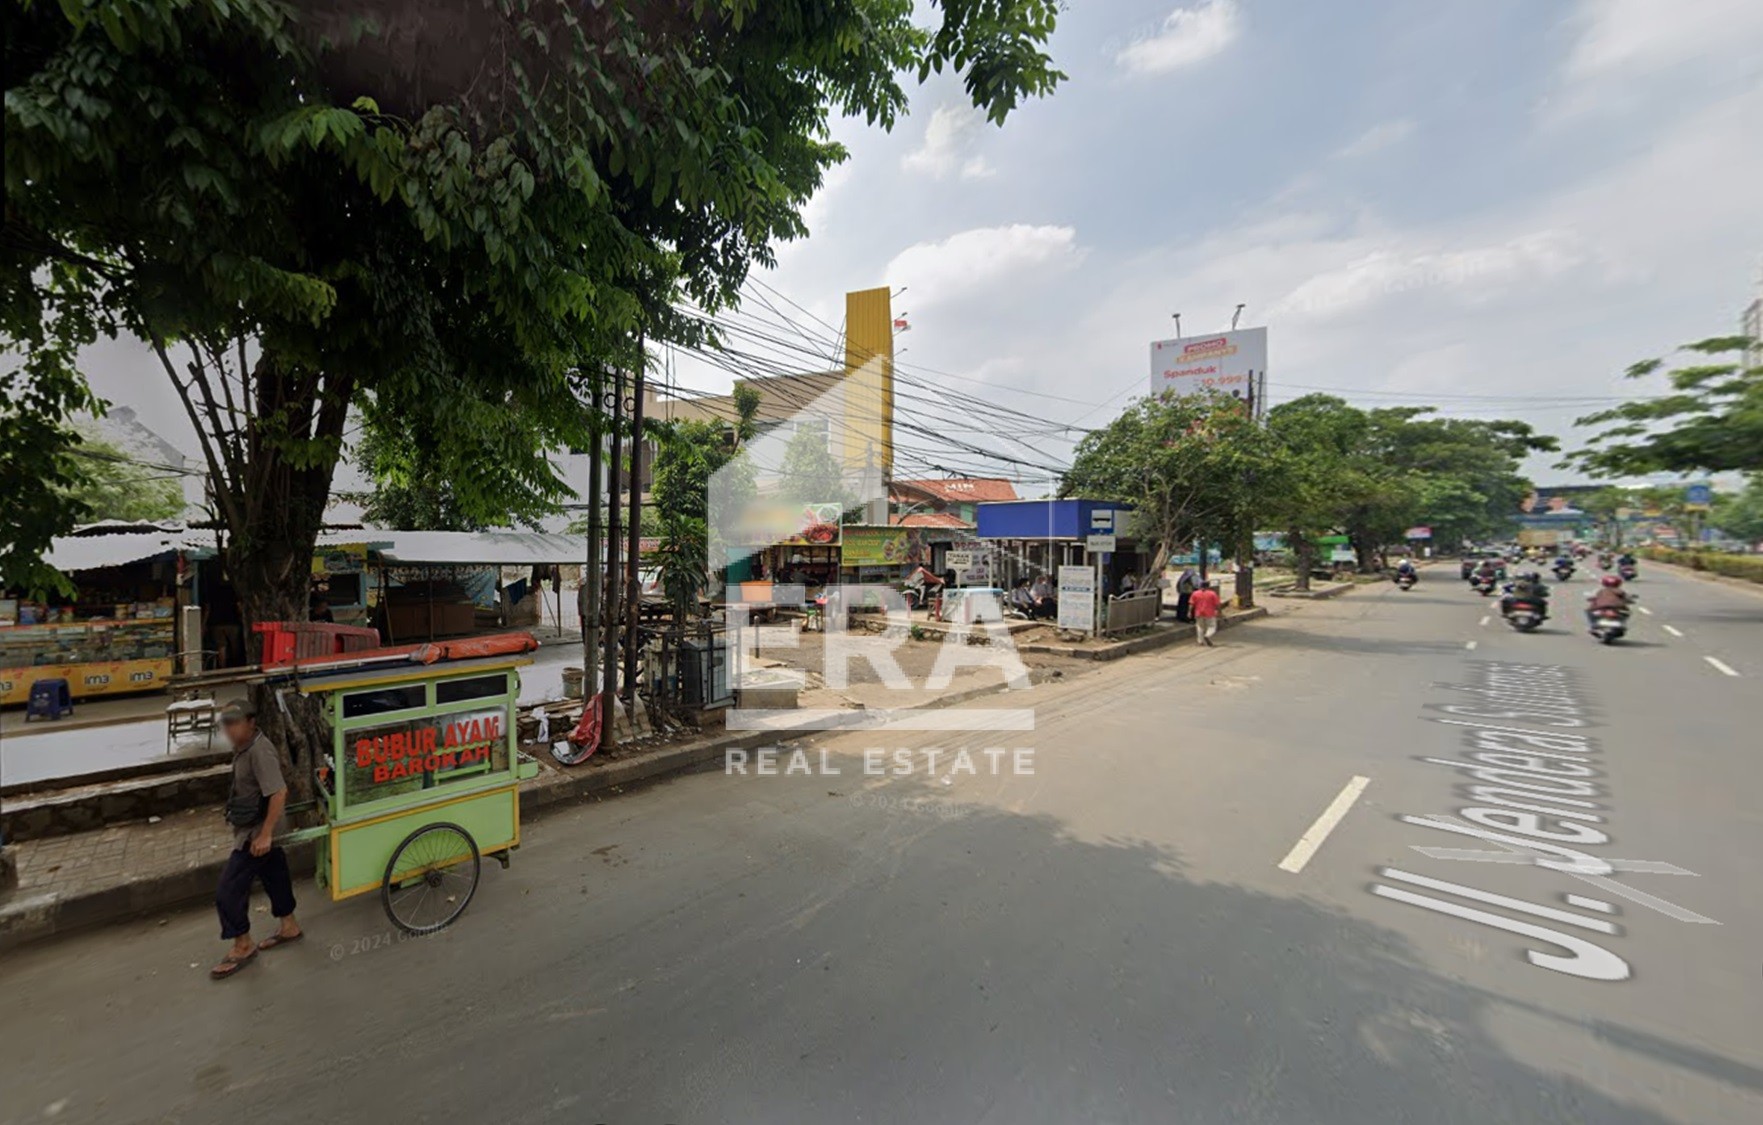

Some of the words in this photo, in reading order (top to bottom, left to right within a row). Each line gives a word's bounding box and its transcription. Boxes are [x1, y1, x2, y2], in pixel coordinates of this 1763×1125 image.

[1163, 366, 1217, 379] Spanduk
[355, 726, 437, 768] BUBUR
[444, 714, 500, 749] AYAM
[372, 745, 490, 784] BAROKAH
